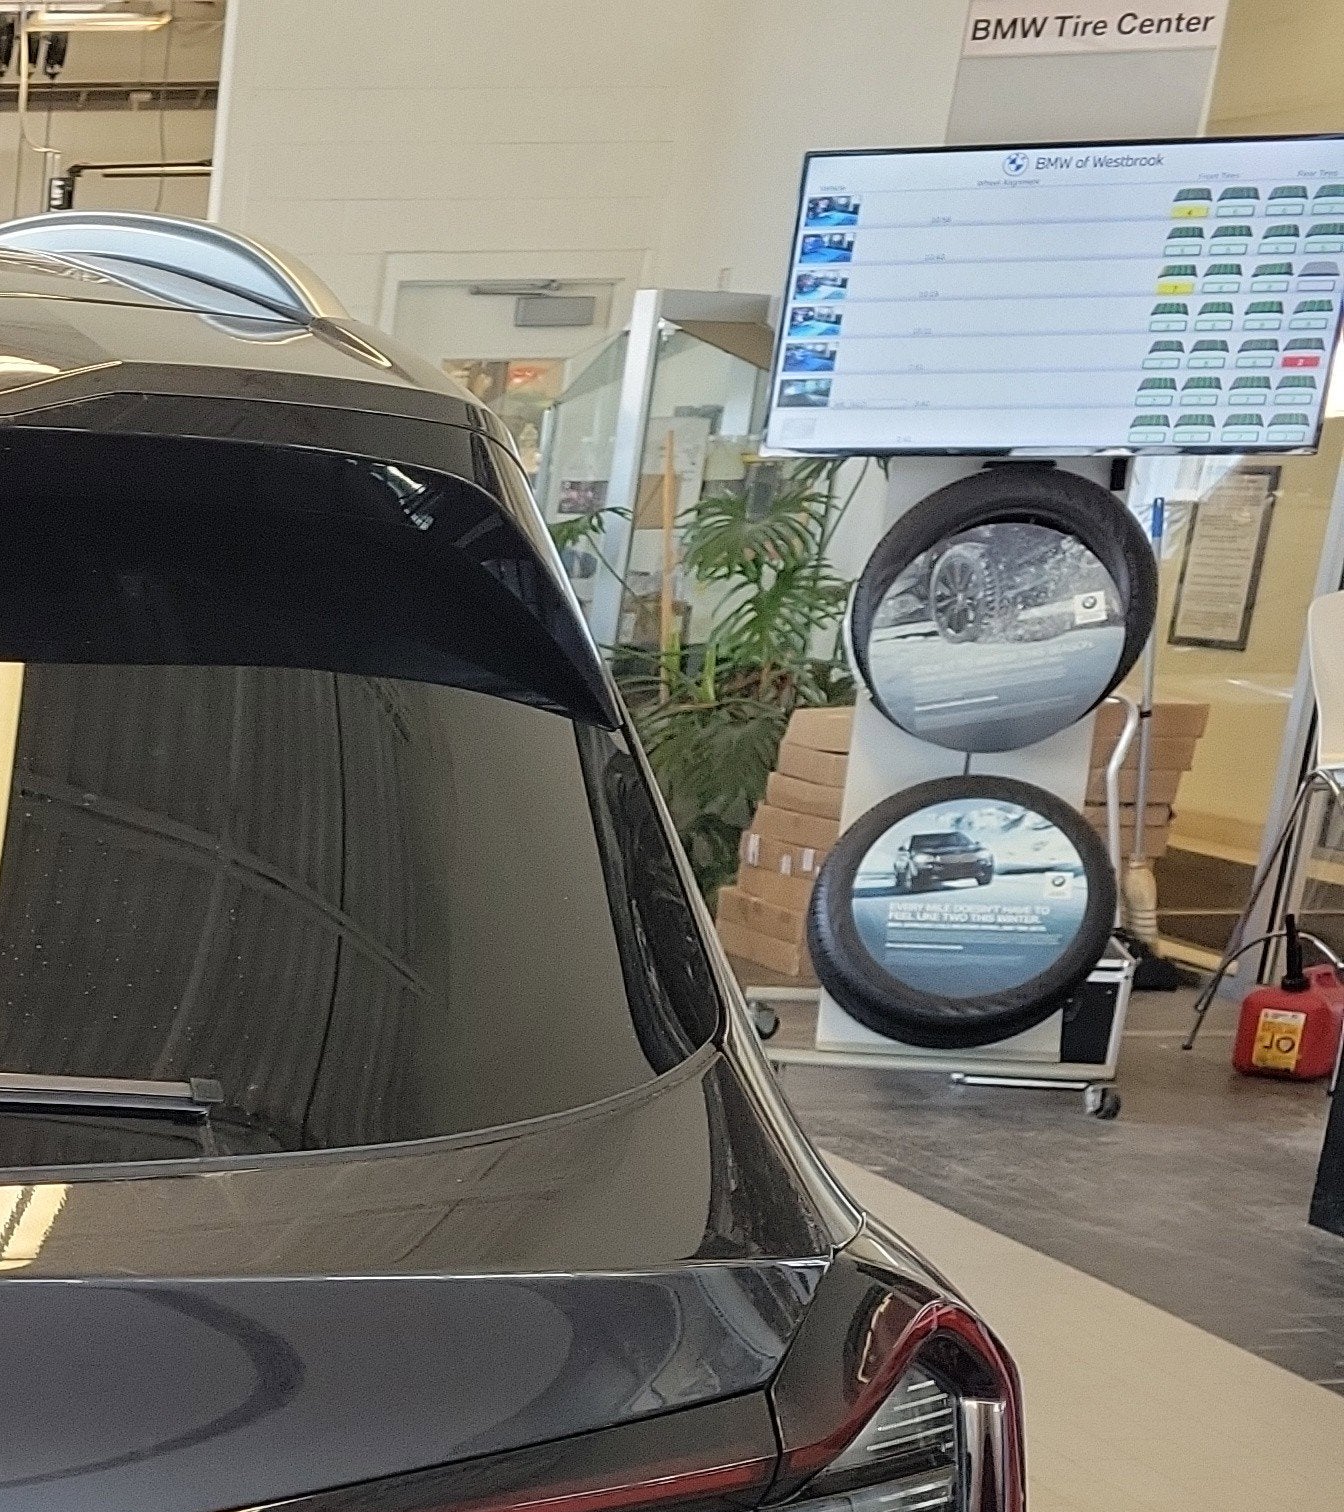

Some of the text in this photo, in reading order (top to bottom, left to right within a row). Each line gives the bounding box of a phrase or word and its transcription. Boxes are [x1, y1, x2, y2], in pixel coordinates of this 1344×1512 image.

[971, 12, 1215, 41] BMW Tire Center
[1035, 154, 1165, 170] BMW of Westbrook
